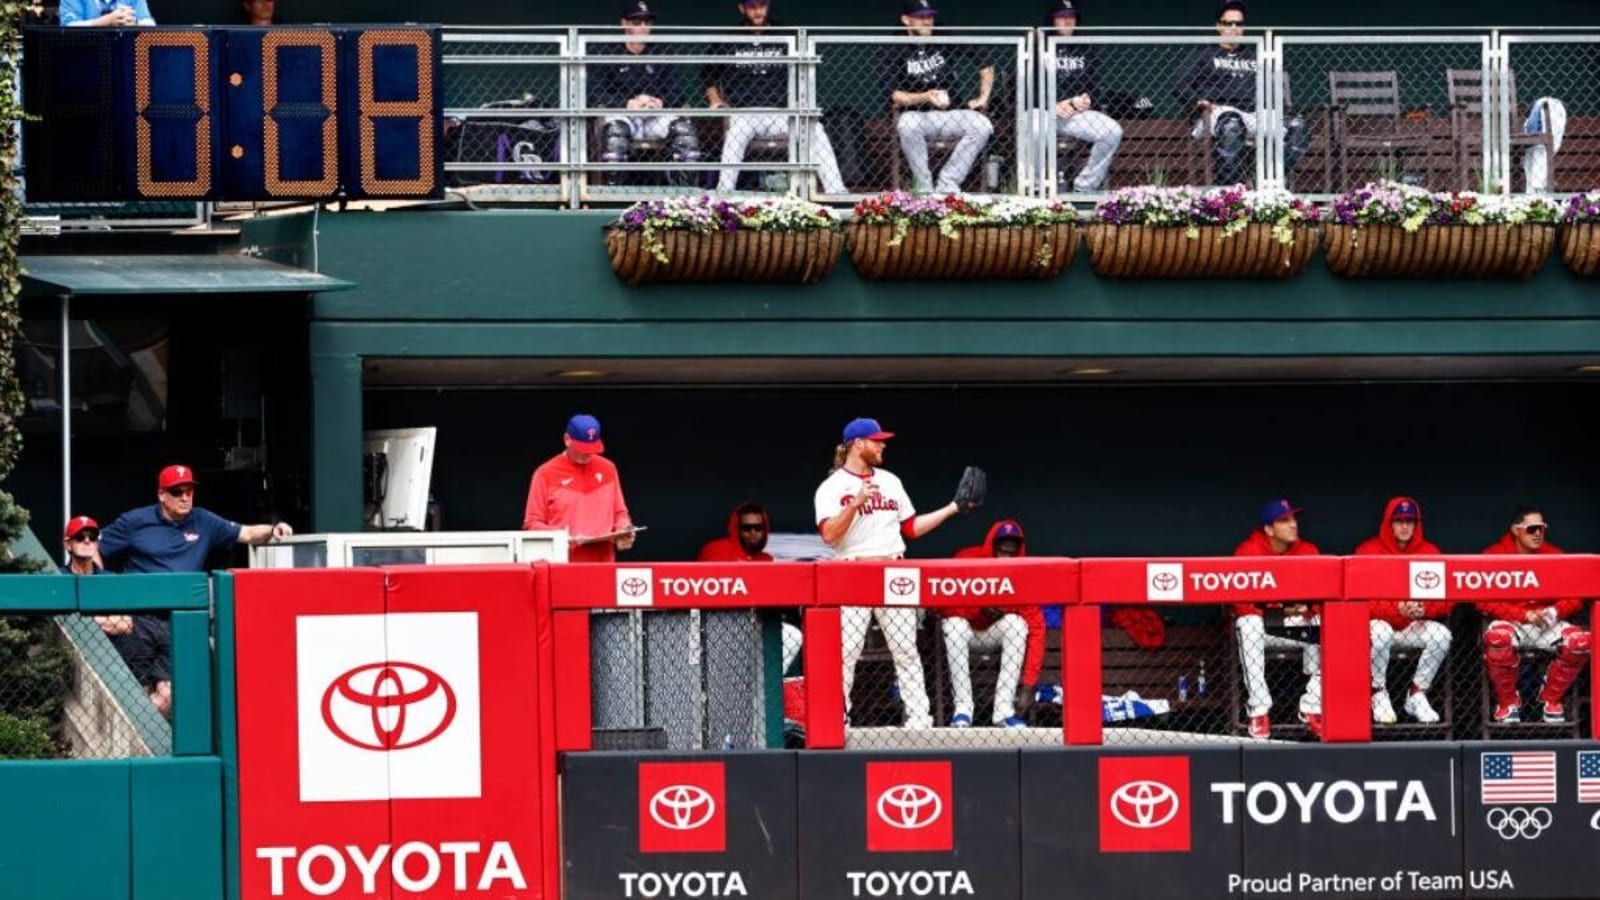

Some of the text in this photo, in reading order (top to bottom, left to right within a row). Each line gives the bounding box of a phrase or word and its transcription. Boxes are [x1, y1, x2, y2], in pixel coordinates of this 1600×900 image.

[135, 31, 434, 197] 0:08
[660, 577, 748, 596] TOYOTA
[927, 577, 1015, 596] TOYOTA
[1190, 571, 1277, 591] TOYOTA
[1452, 570, 1539, 589] TOYOTA
[1210, 779, 1437, 825] TOYOTA
[256, 841, 527, 896] TOYOTA
[618, 871, 748, 898] TOYOTA
[846, 870, 975, 897] TOYOTA
[1228, 870, 1514, 893] Proud Partner of Team USA
